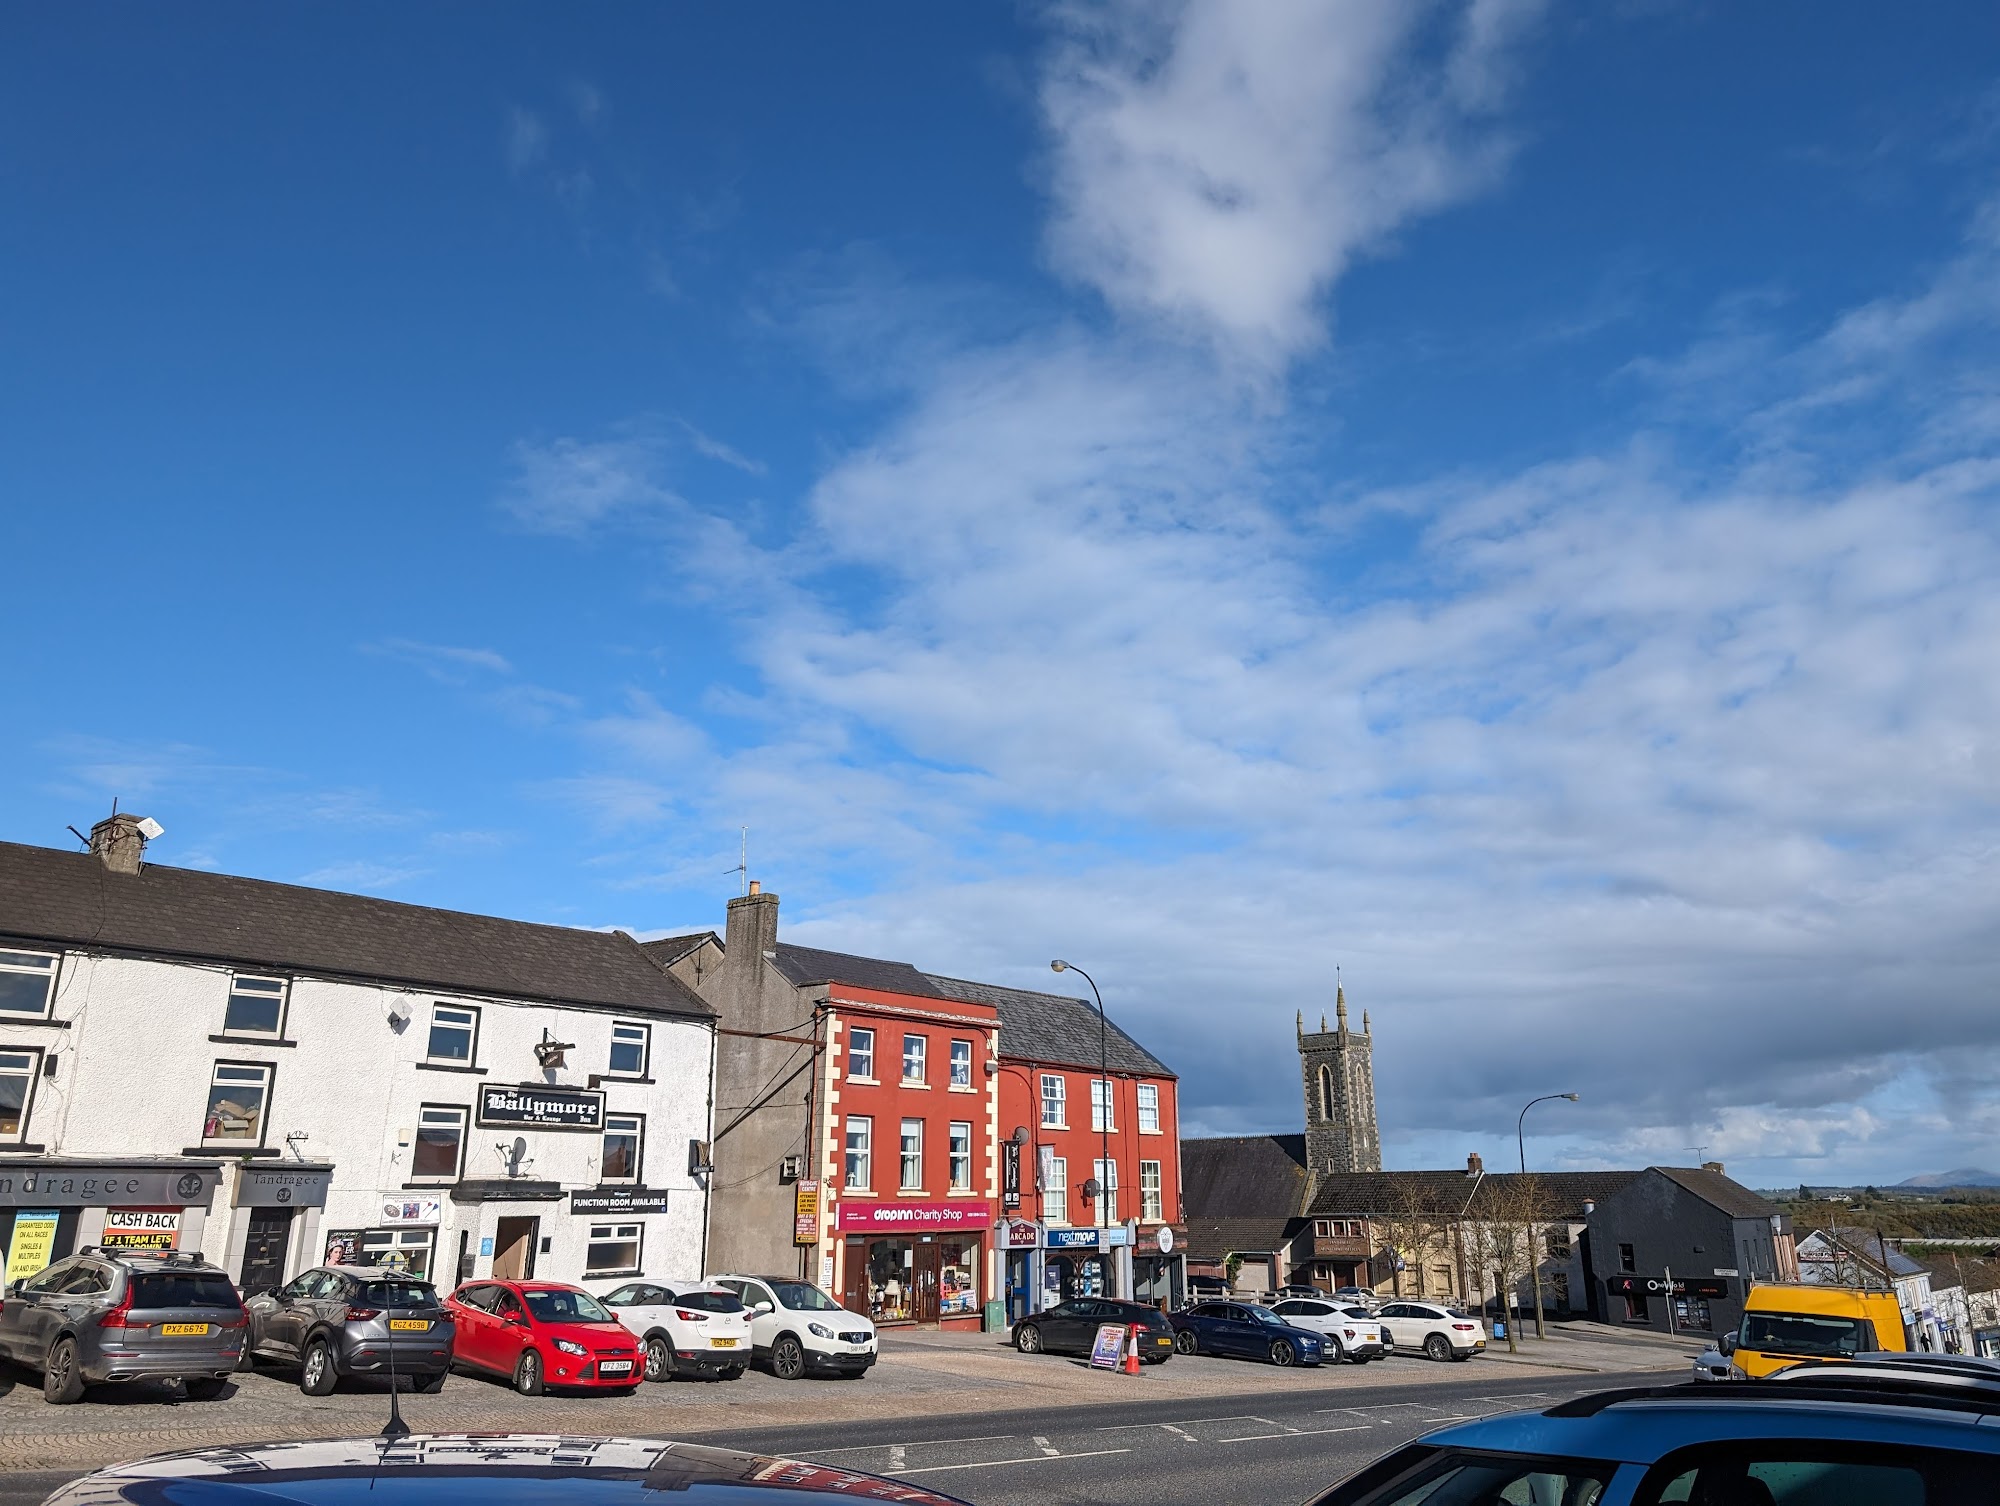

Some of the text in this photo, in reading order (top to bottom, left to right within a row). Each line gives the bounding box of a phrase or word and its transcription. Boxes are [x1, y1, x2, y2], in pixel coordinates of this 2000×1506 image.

[487, 1093, 597, 1115] Ballymore
[579, 1115, 591, 1123] Inn
[253, 1173, 319, 1186] Tandragee
[573, 1198, 666, 1207] FUNCTION ROOM AVAILABLE
[914, 1209, 942, 1222] Charity
[942, 1208, 963, 1222] Shop
[111, 1212, 177, 1228] CASH BACK
[104, 1235, 172, 1245] IF 1 TEAM LETS
[1010, 1232, 1035, 1240] ARCADE
[165, 1325, 204, 1333] PXZ 6675
[393, 1321, 407, 1329] RGZ
